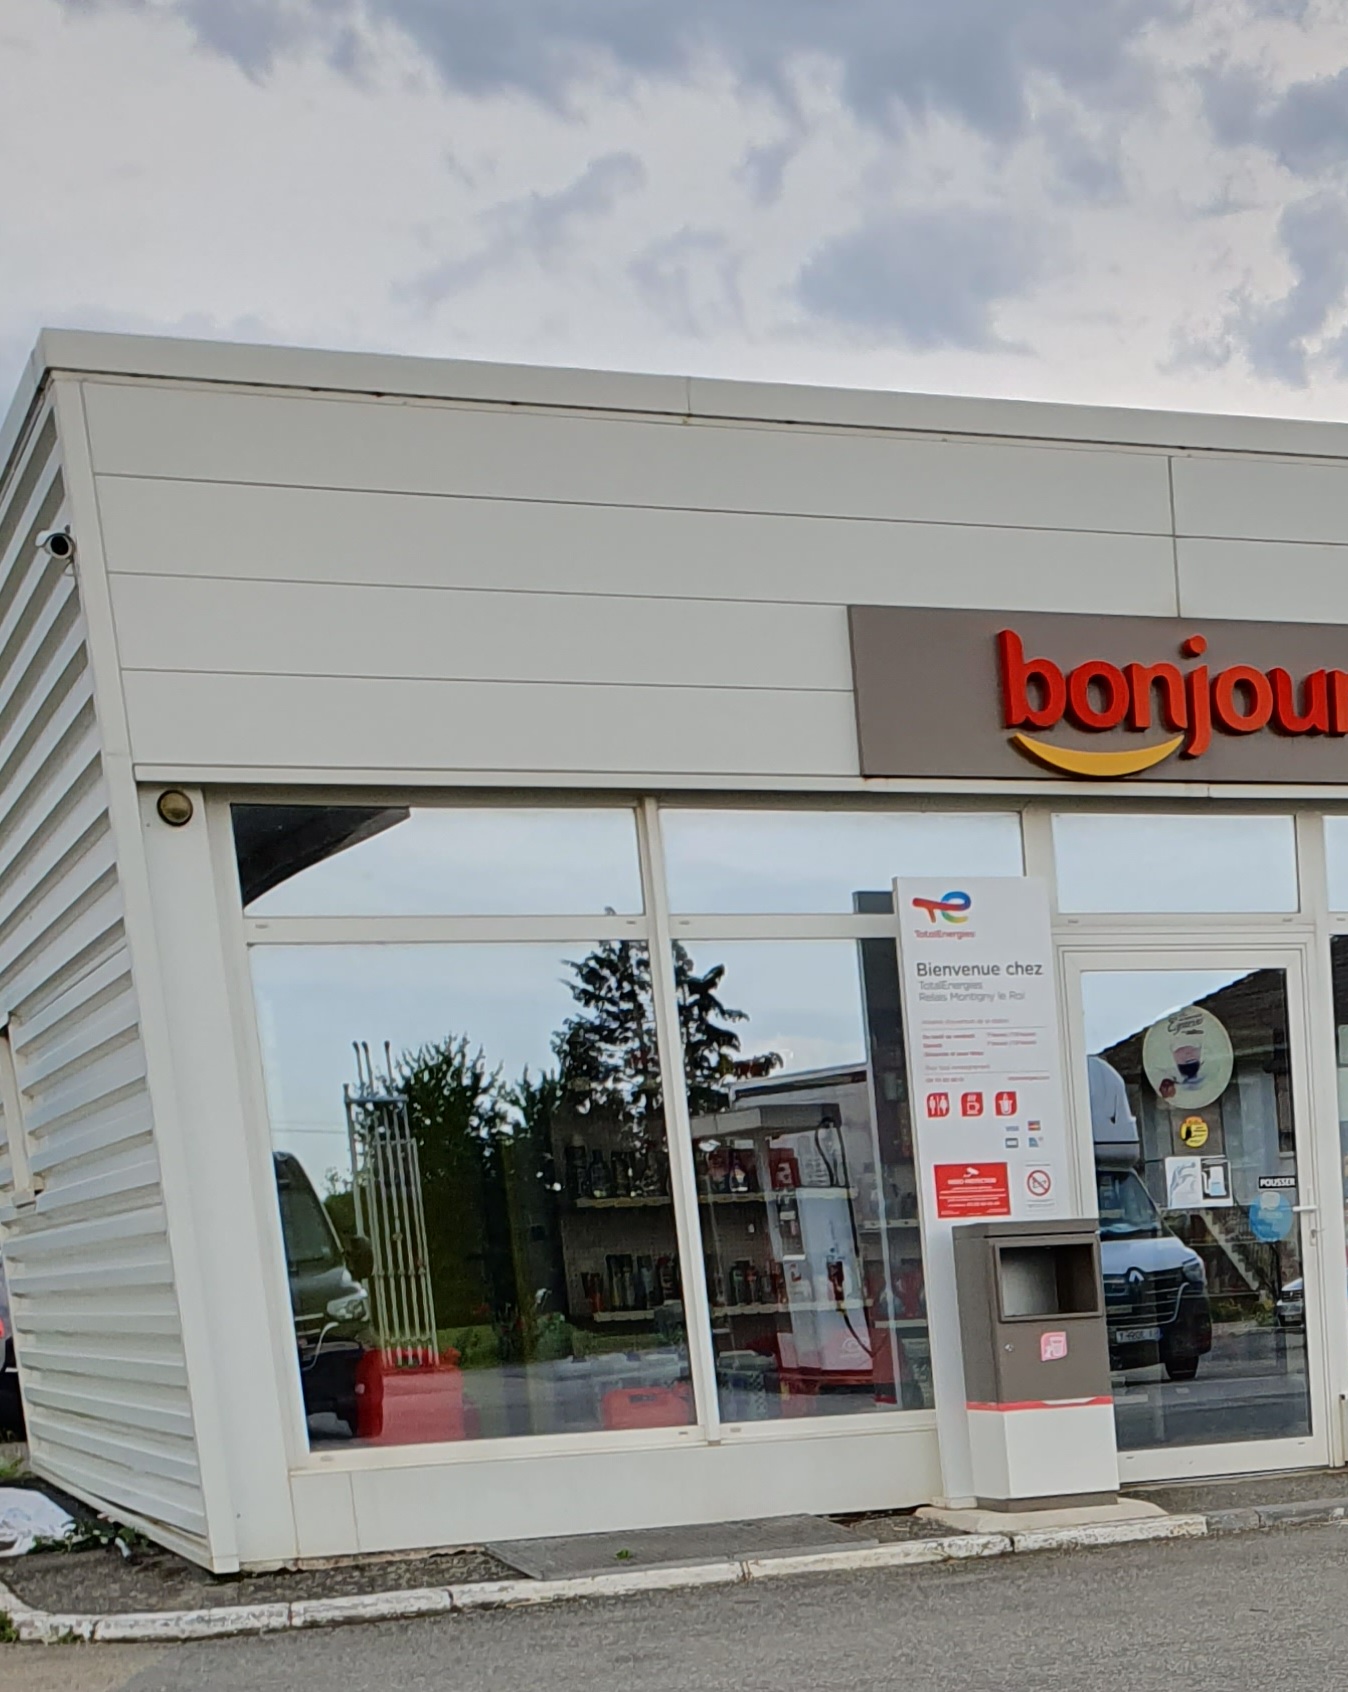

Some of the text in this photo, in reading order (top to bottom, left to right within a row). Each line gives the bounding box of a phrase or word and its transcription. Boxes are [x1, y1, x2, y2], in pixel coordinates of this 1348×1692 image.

[916, 961, 1044, 977] Bienvenue chez
[1260, 1177, 1296, 1187] POUSSER
